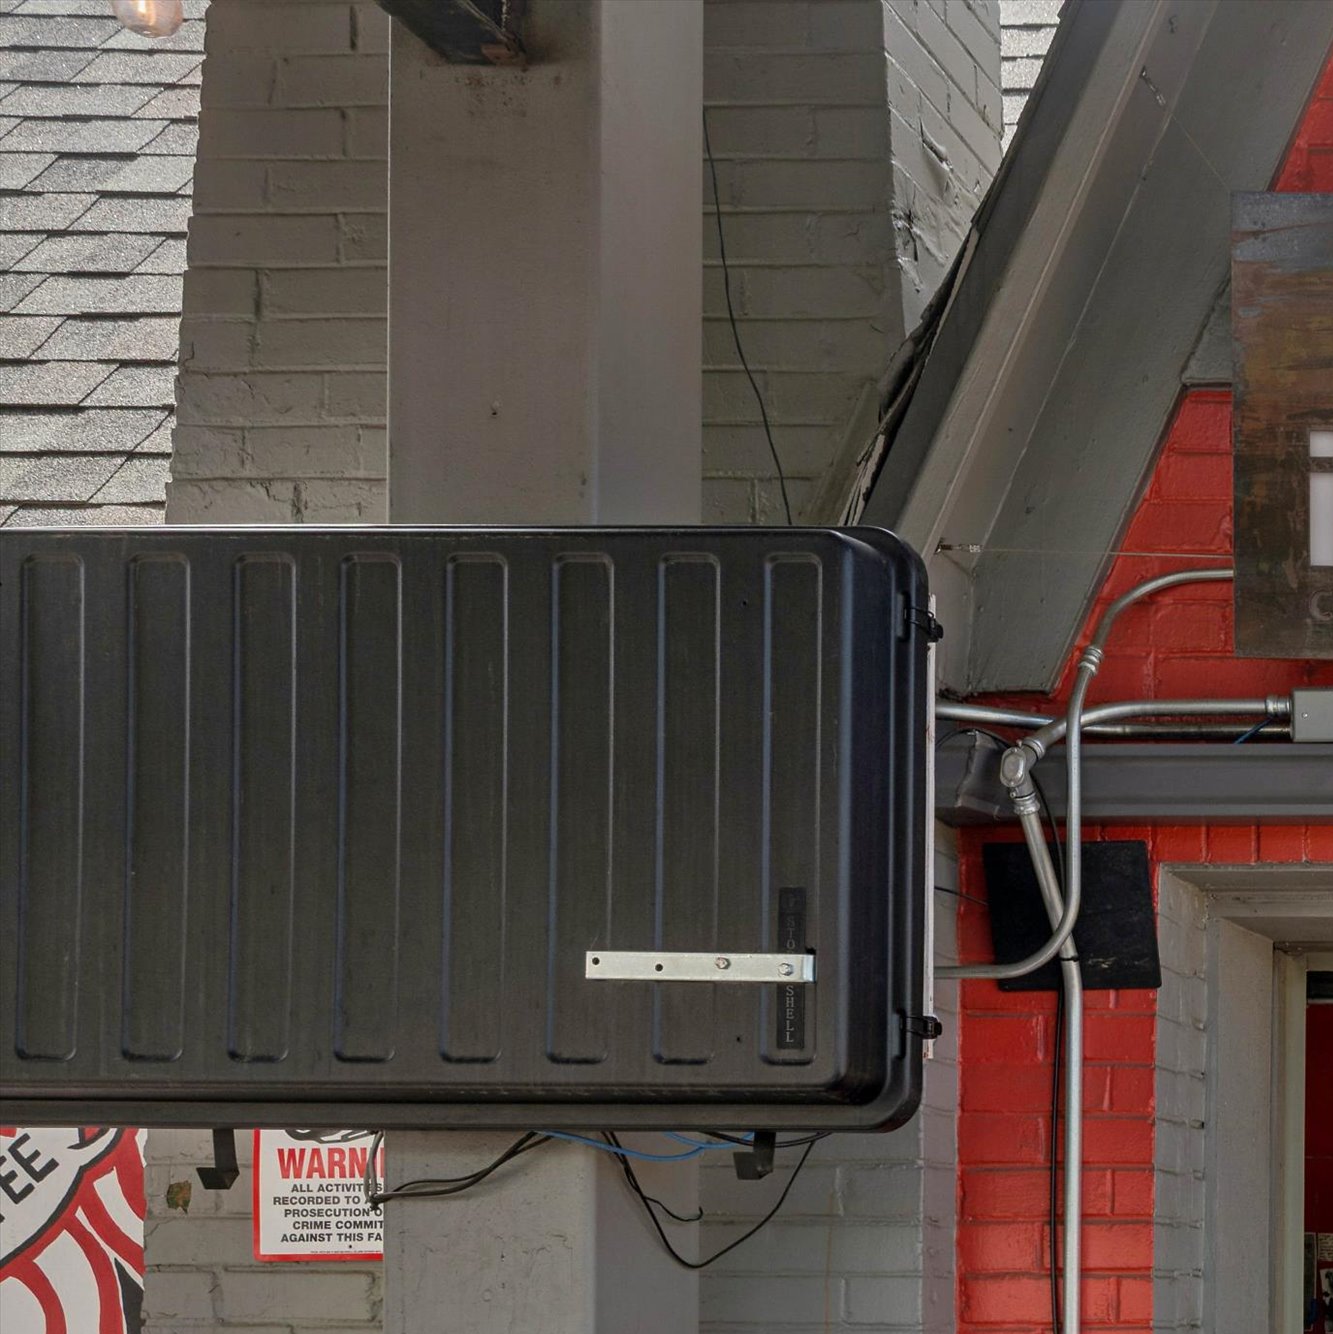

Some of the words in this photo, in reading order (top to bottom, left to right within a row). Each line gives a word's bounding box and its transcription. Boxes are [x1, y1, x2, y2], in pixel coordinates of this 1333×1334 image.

[277, 1147, 384, 1179] WARN
[0, 1132, 60, 1205] EE
[291, 1183, 313, 1192] ALL
[317, 1183, 383, 1192] ACTIVITS
[273, 1196, 340, 1205] RECORDED
[345, 1196, 360, 1205] TO
[284, 1208, 370, 1217] PROSECUTION
[293, 1220, 331, 1230] CRIME
[281, 1233, 333, 1242] AGAINST
[337, 1232, 363, 1241] THIS
[367, 1232, 383, 1241] FA
